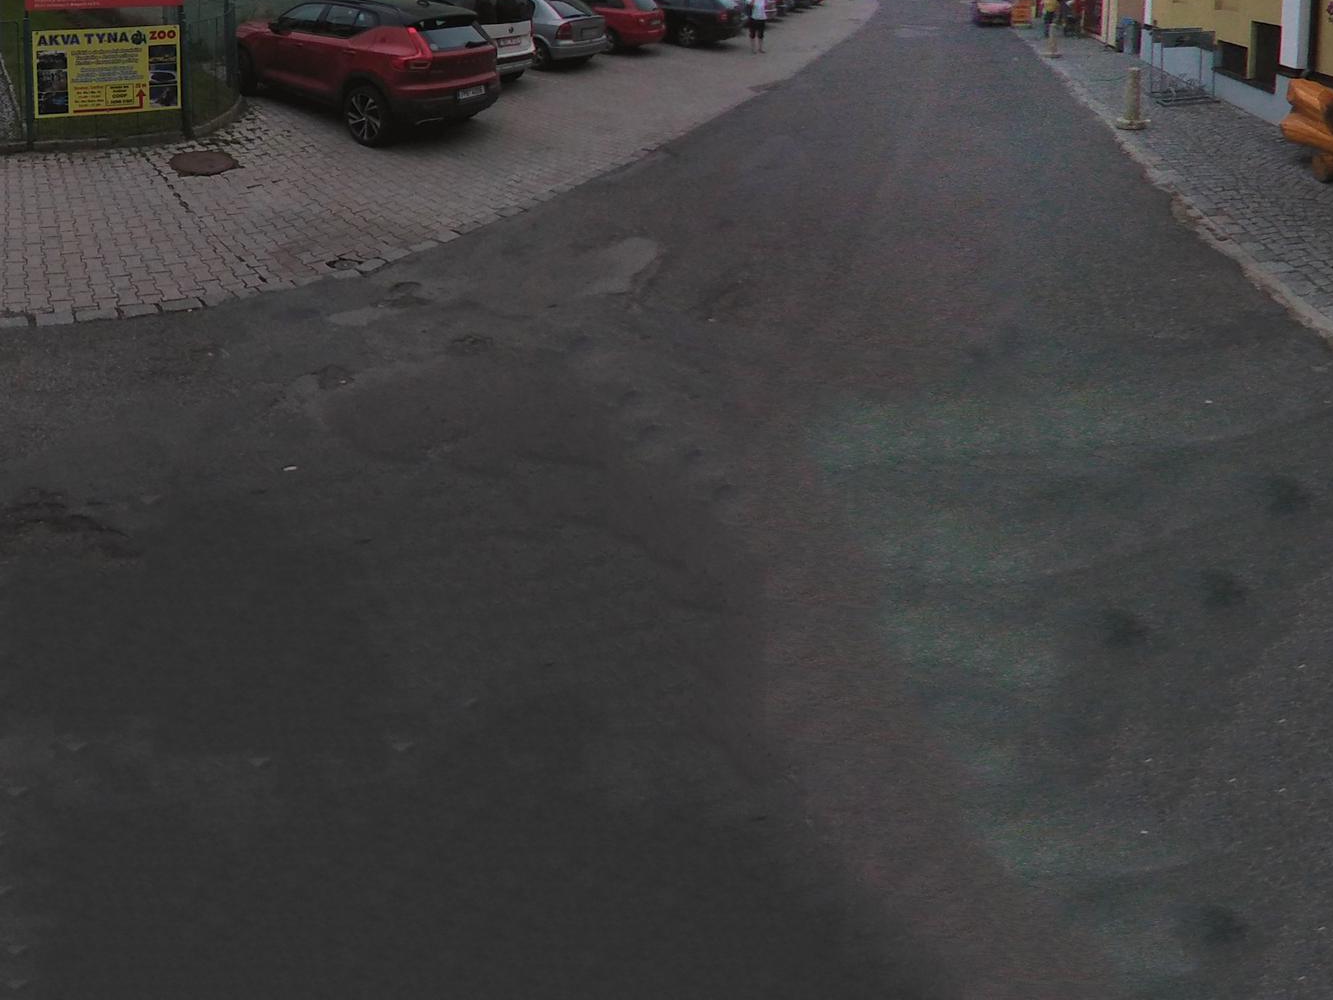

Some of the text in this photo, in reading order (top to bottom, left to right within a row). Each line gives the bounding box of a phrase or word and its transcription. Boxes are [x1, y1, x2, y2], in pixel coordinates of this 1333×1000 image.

[38, 30, 176, 46] AKVA TYNA ZOO
